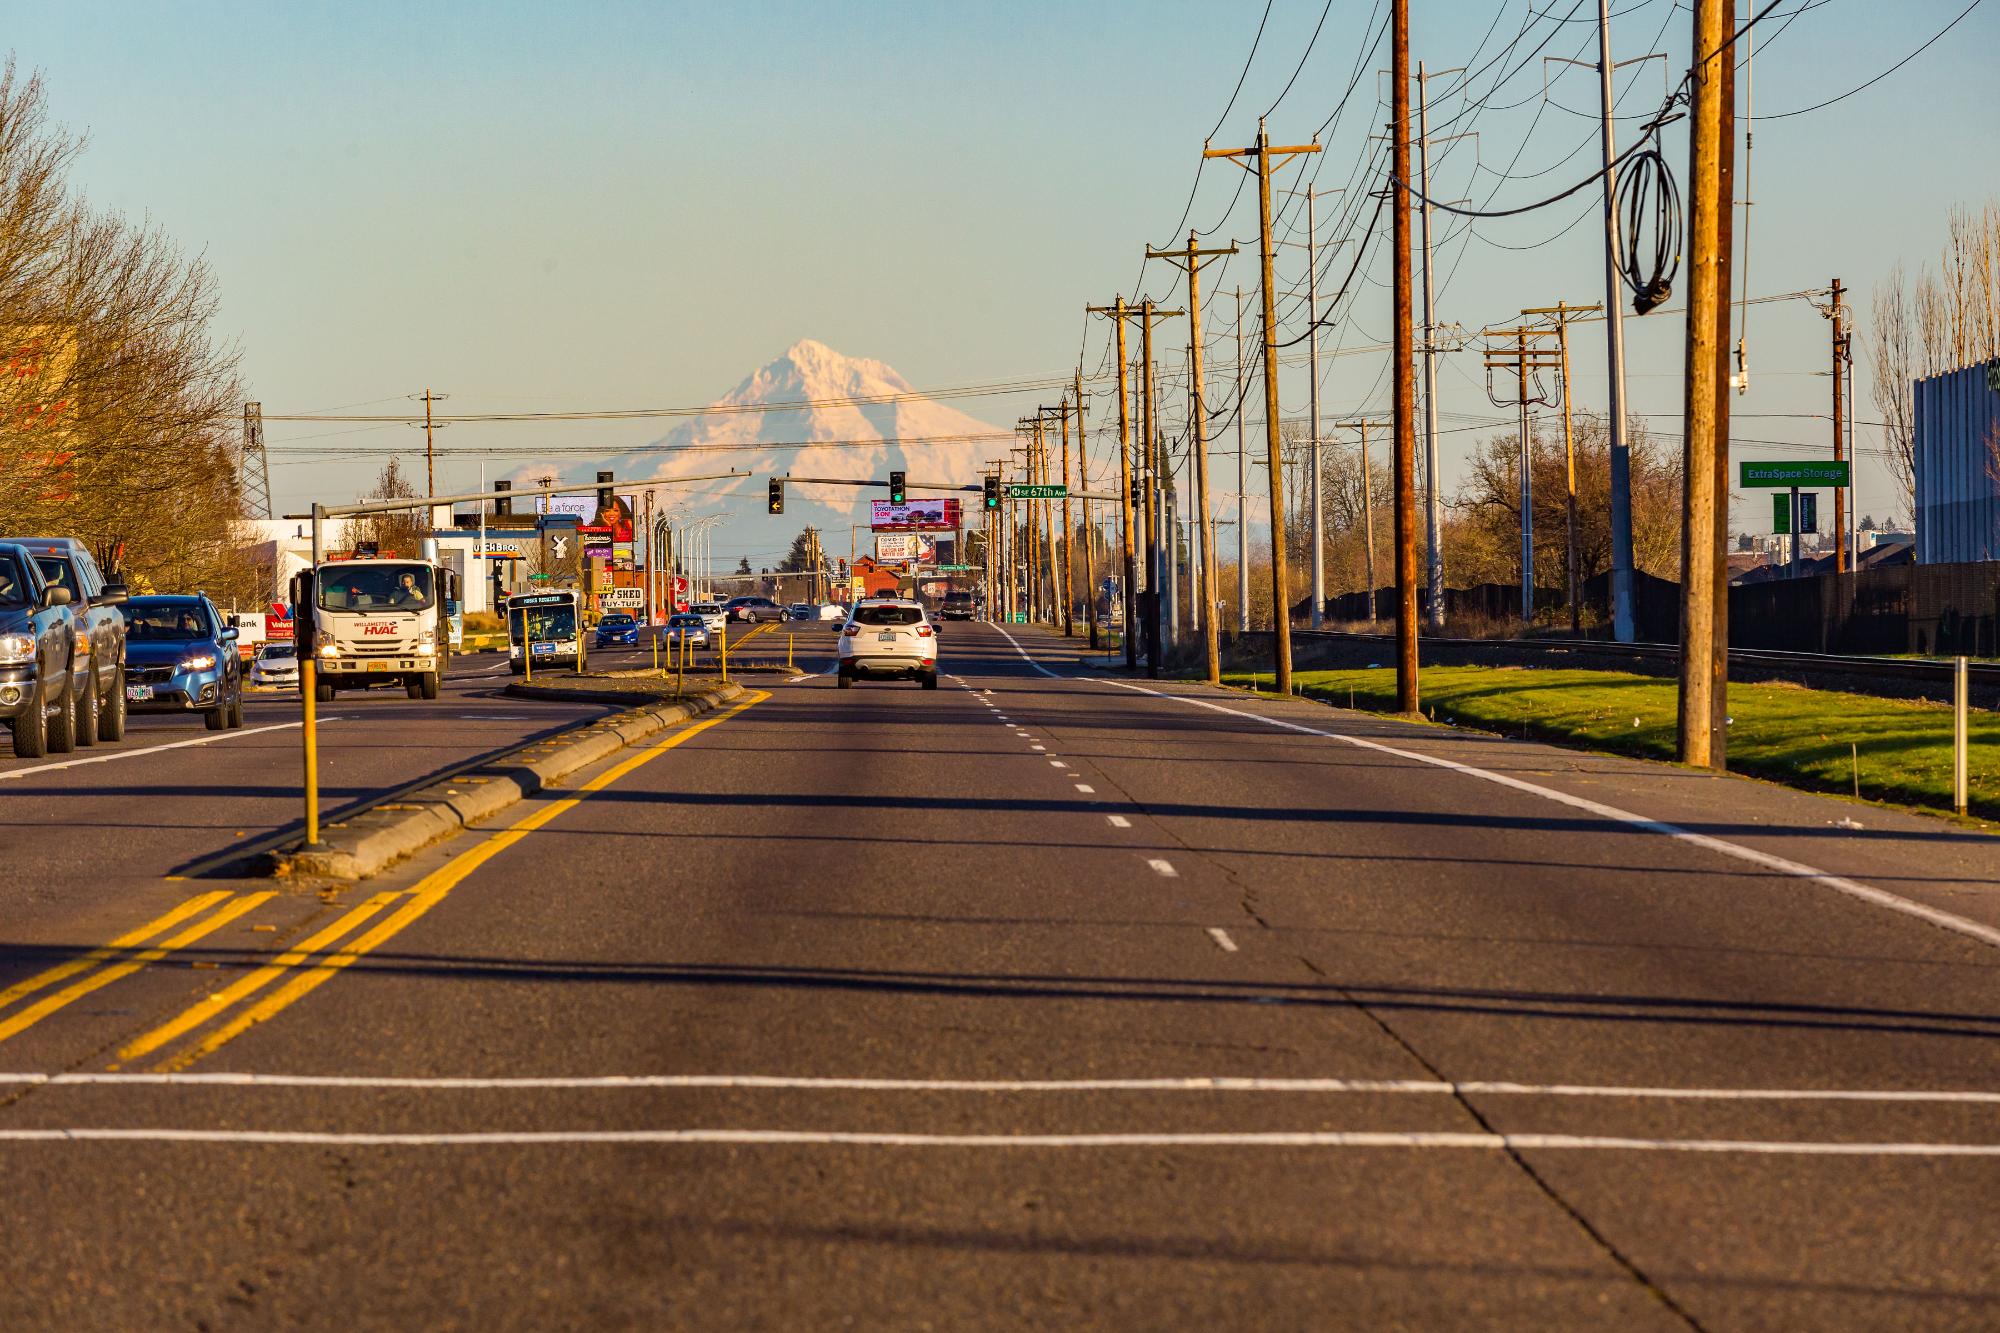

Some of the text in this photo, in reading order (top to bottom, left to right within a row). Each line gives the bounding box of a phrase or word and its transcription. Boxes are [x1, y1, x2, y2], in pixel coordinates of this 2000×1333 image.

[1748, 468, 1842, 480] ExtraSpace Storage
[1030, 487, 1054, 497] 67th
[562, 503, 585, 512] force
[617, 590, 641, 599] SHED
[364, 626, 398, 634] HVAC
